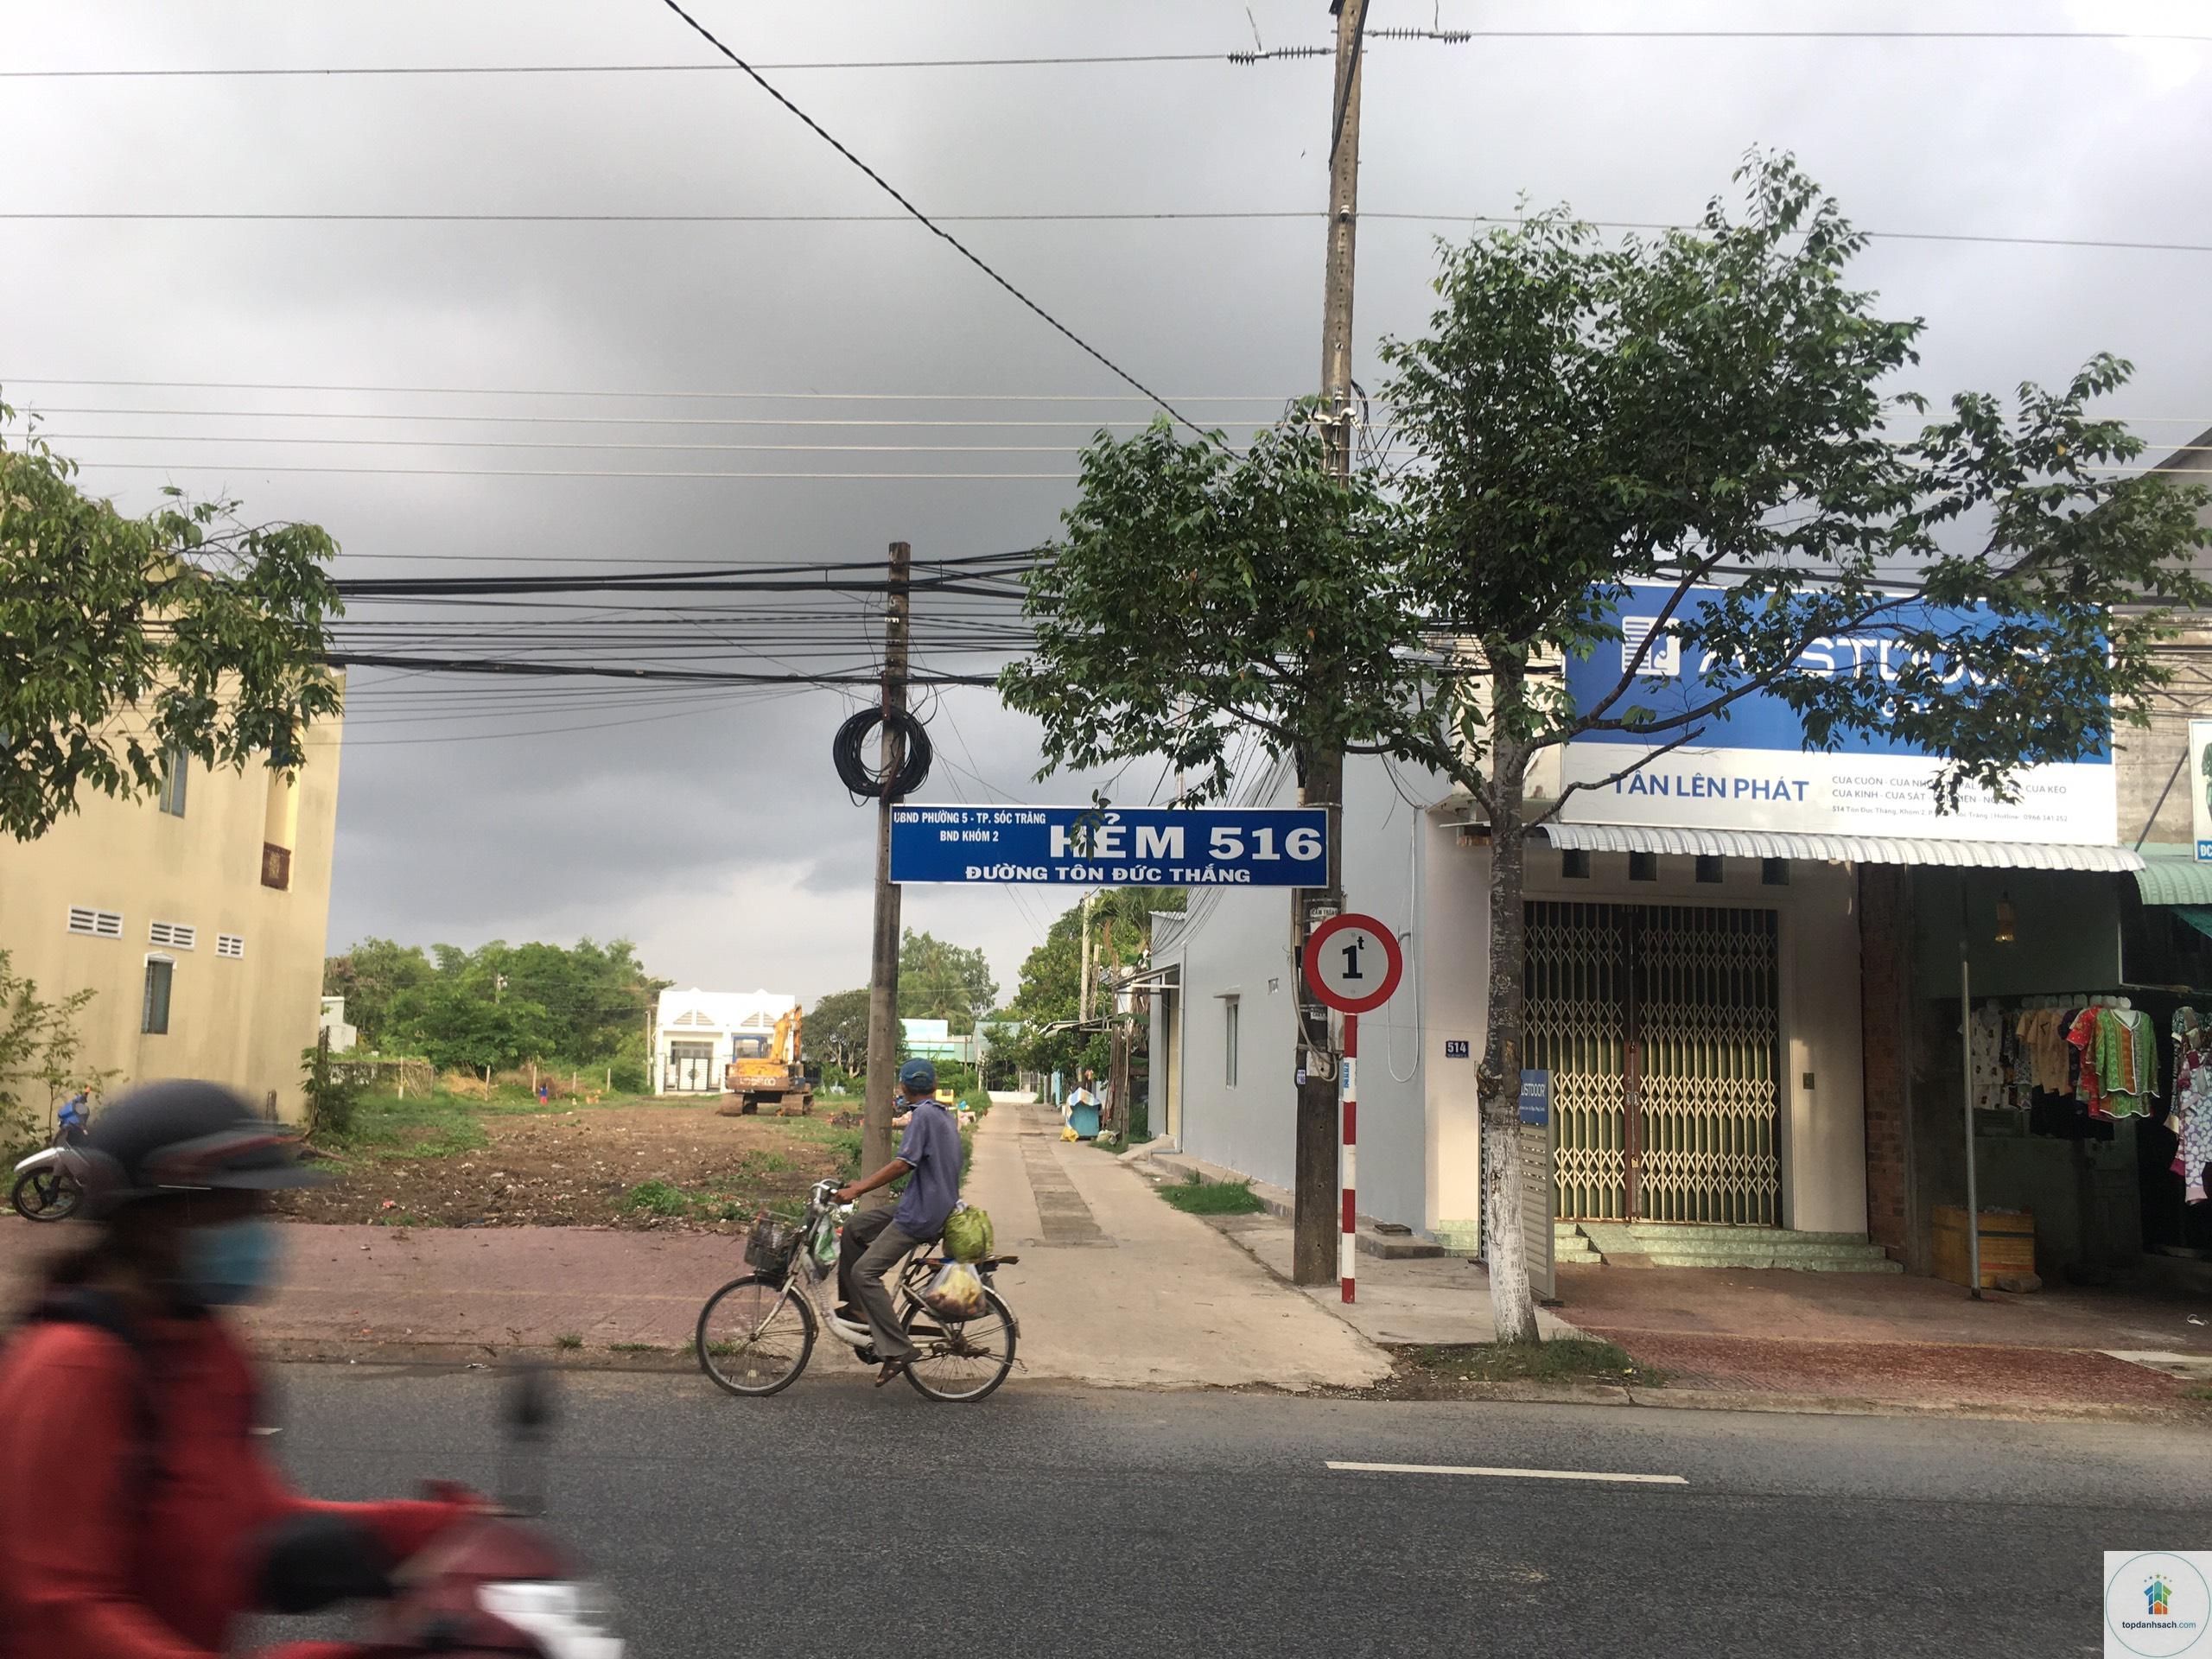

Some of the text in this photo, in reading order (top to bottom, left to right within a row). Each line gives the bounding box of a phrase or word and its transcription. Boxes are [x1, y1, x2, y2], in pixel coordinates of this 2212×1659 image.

[1610, 770, 1810, 802] TÂN LÊN PHÁT
[893, 812, 918, 823] UBND
[922, 810, 959, 823] PHƯỜNG
[962, 812, 968, 823] 5
[976, 813, 991, 824] TP.
[994, 810, 1013, 824] SÓC
[1014, 810, 1046, 824] TRĂNG
[940, 828, 999, 842] BND KHÓM 2
[1209, 827, 1323, 861] 516
[965, 862, 1250, 883] ĐƯỜNG TÔN ĐỨC THẮNG
[1447, 1042, 1466, 1052] 514
